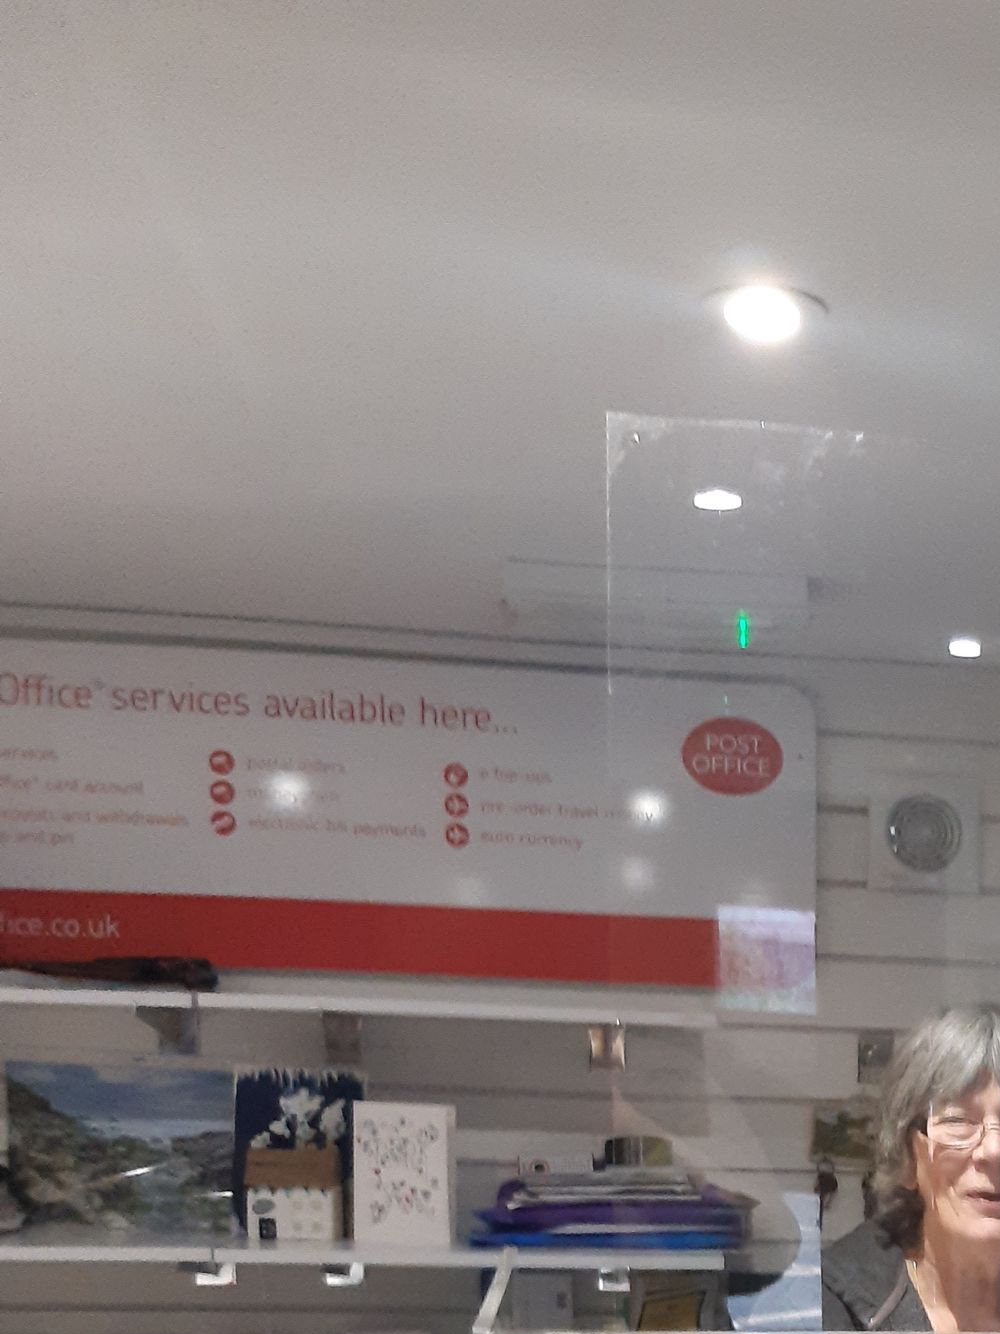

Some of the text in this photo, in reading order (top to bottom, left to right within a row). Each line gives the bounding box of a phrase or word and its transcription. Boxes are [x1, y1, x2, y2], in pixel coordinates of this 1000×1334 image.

[112, 682, 250, 716] services
[264, 690, 406, 725] available
[705, 732, 762, 755] POST
[692, 752, 771, 777] OFFICE
